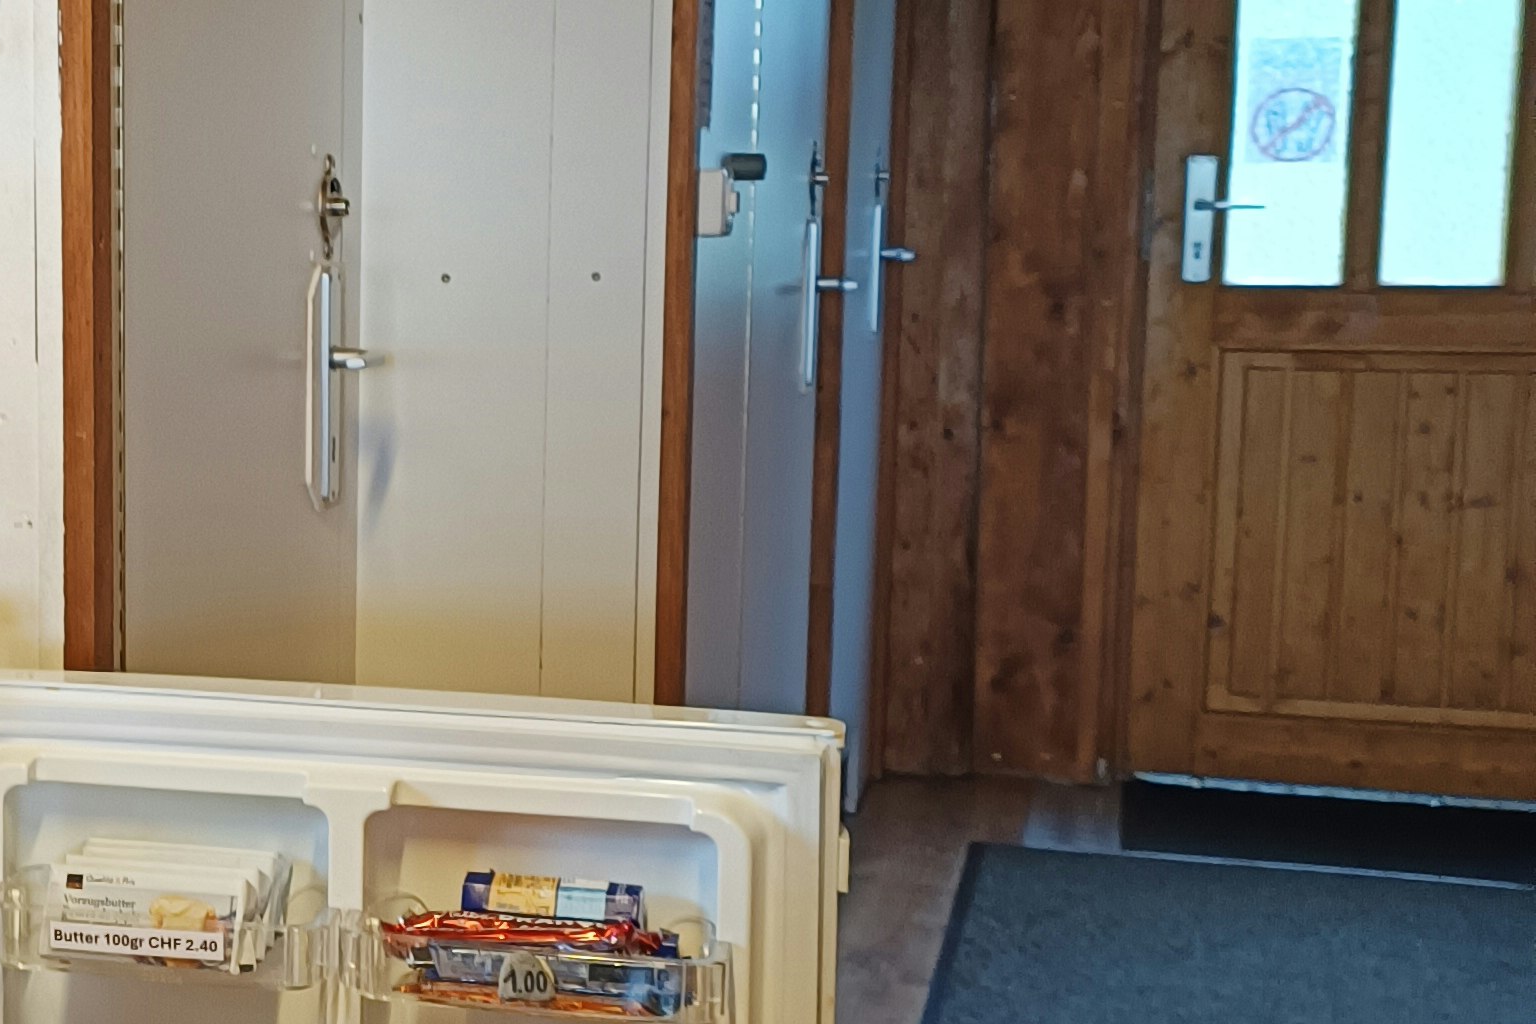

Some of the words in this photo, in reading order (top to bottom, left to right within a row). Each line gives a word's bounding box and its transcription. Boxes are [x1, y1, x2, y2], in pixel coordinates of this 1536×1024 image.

[53, 929, 100, 944] Butter
[104, 934, 144, 950] 100gr
[148, 936, 182, 950] CHF
[185, 939, 218, 952] 2.40
[503, 969, 549, 994] 1.00
